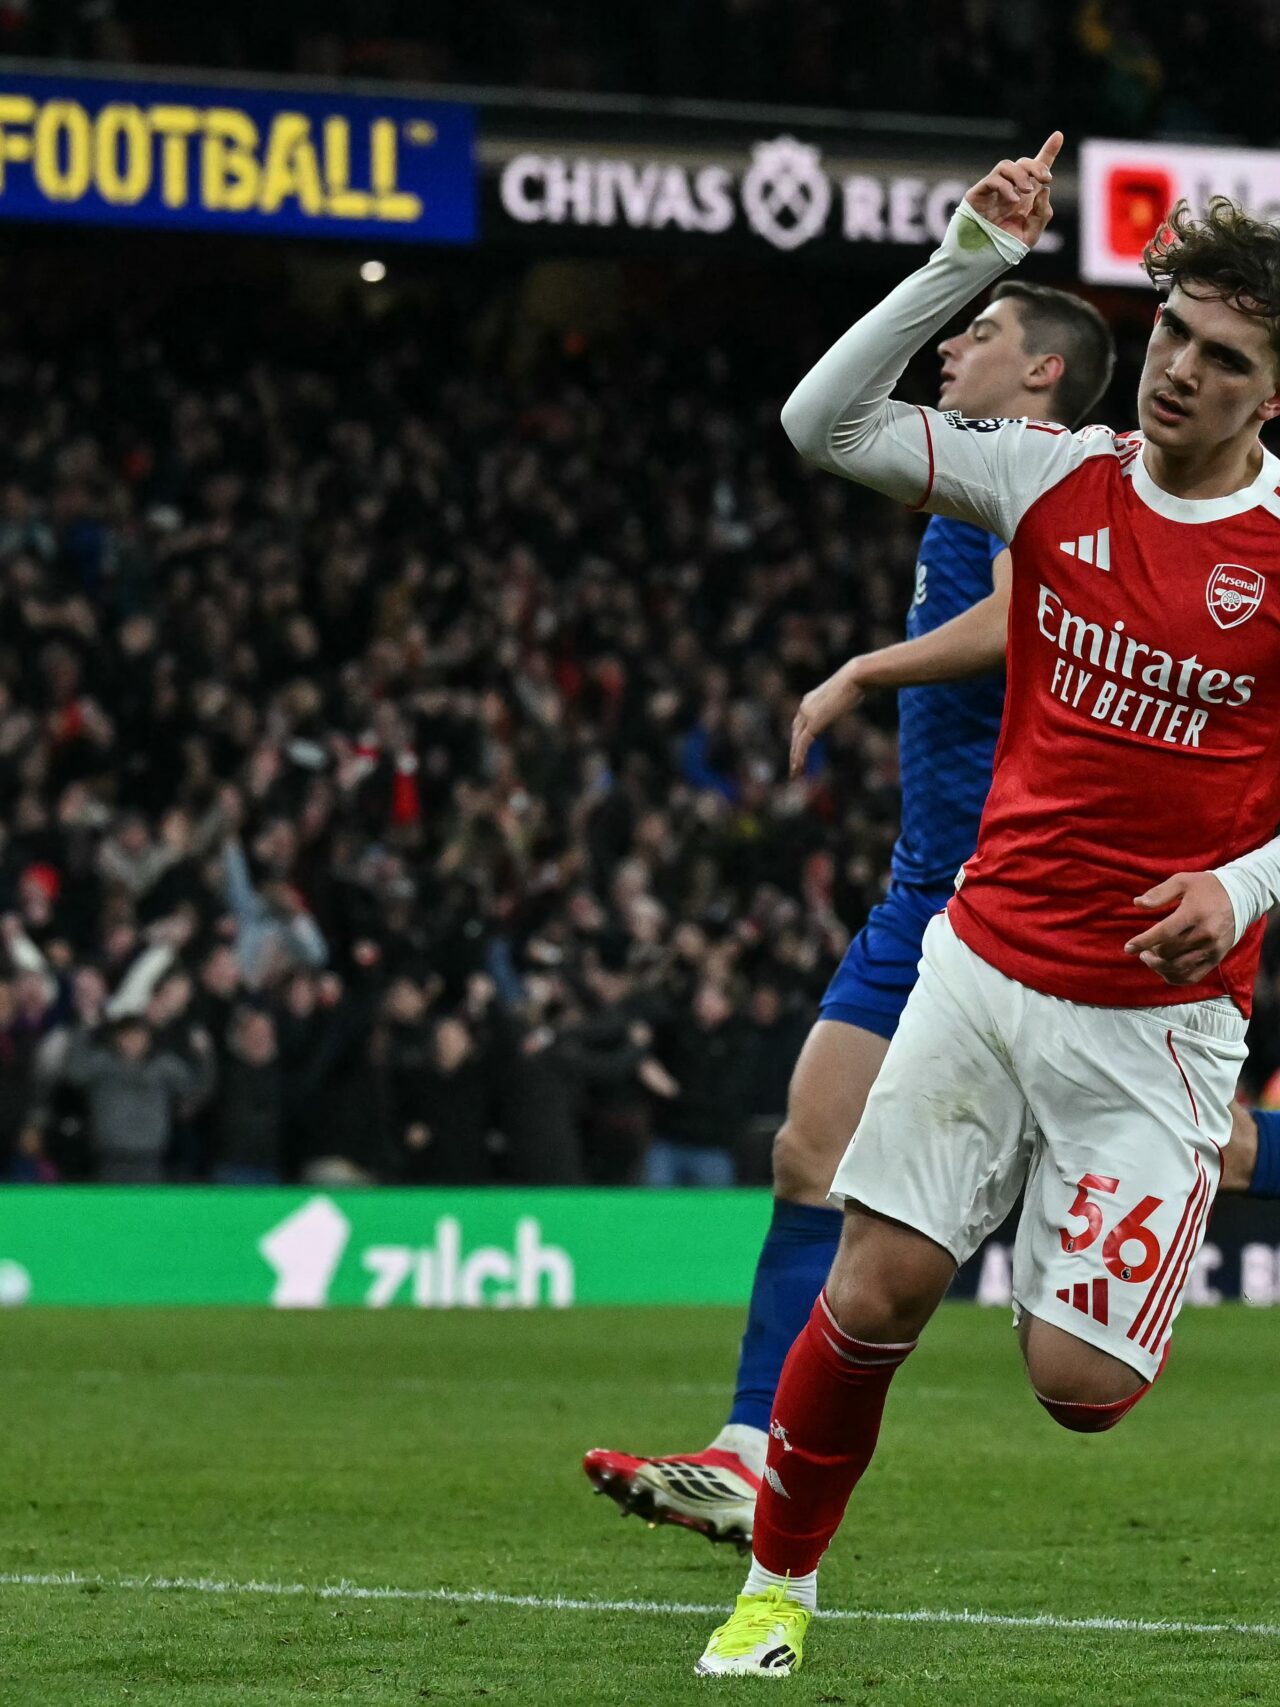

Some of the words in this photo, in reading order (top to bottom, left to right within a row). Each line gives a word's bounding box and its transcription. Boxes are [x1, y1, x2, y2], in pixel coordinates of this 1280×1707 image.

[0, 96, 422, 222] FOOTBALL
[501, 154, 736, 234] CHIVAS
[1217, 573, 1258, 592] Arsenal
[1037, 583, 1256, 707] Emirates
[1050, 657, 1093, 709] FLY
[1091, 681, 1209, 748] BETTER
[362, 1215, 574, 1308] zilch
[1058, 1173, 1163, 1283] 56
